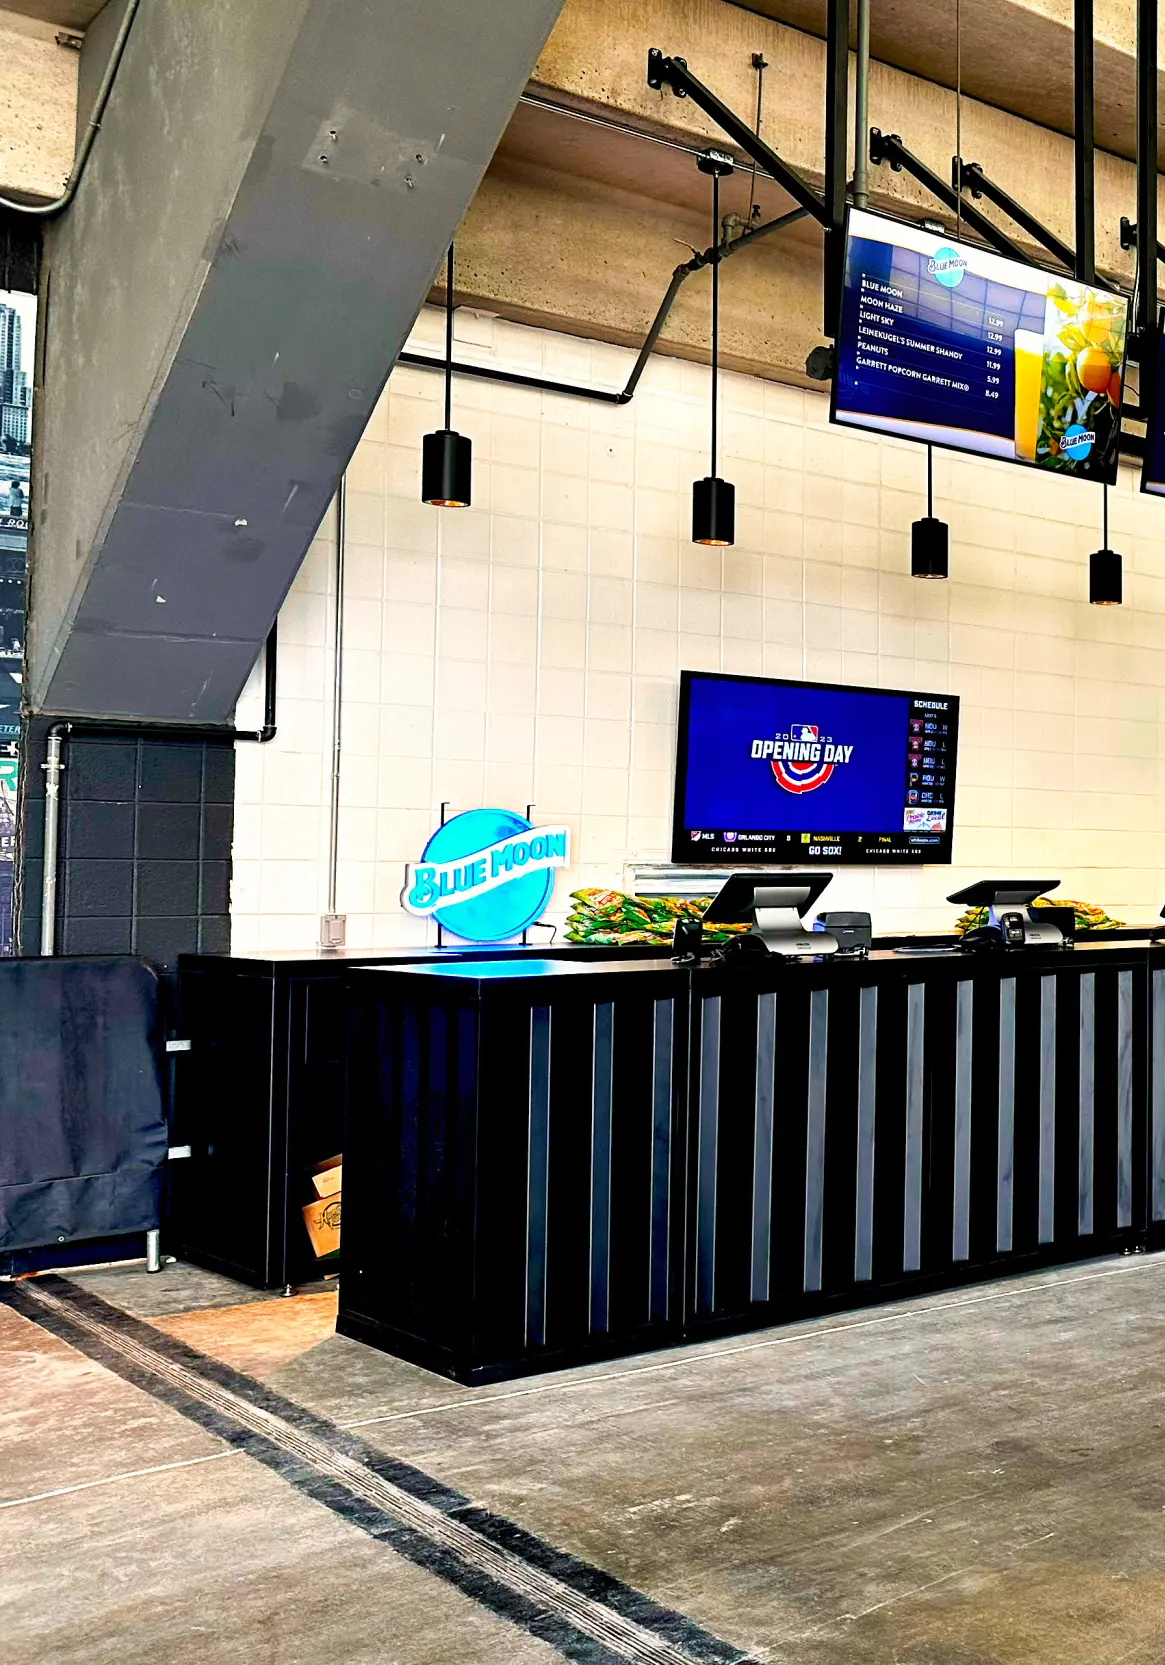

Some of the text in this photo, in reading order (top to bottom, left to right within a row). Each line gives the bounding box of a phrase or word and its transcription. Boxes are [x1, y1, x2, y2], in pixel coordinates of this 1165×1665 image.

[929, 258, 968, 272] BLUE MOON
[862, 280, 903, 298] BLUE MOON
[860, 296, 903, 314] MOON HAZE
[860, 310, 894, 326] LIGHT SKY
[988, 317, 1004, 328] 12.99
[988, 332, 1003, 342] 12.99
[858, 342, 888, 356] PEANUTS
[906, 338, 935, 353] SUMMER
[936, 346, 963, 360] SHANDY
[986, 346, 1002, 356] 12.99
[856, 356, 888, 371] GARRETT
[888, 364, 922, 379] POPCORN
[922, 374, 952, 387] GARRETT
[986, 360, 1000, 370] 11.99
[986, 376, 1000, 384] 5.99
[985, 390, 999, 398] 8.49
[1060, 433, 1094, 448] BLUE MOON
[914, 700, 948, 710] SCHEDULE
[750, 740, 854, 764] OPENING DAY
[808, 846, 842, 855] GO SOX!
[408, 832, 567, 906] BLUE MOON
